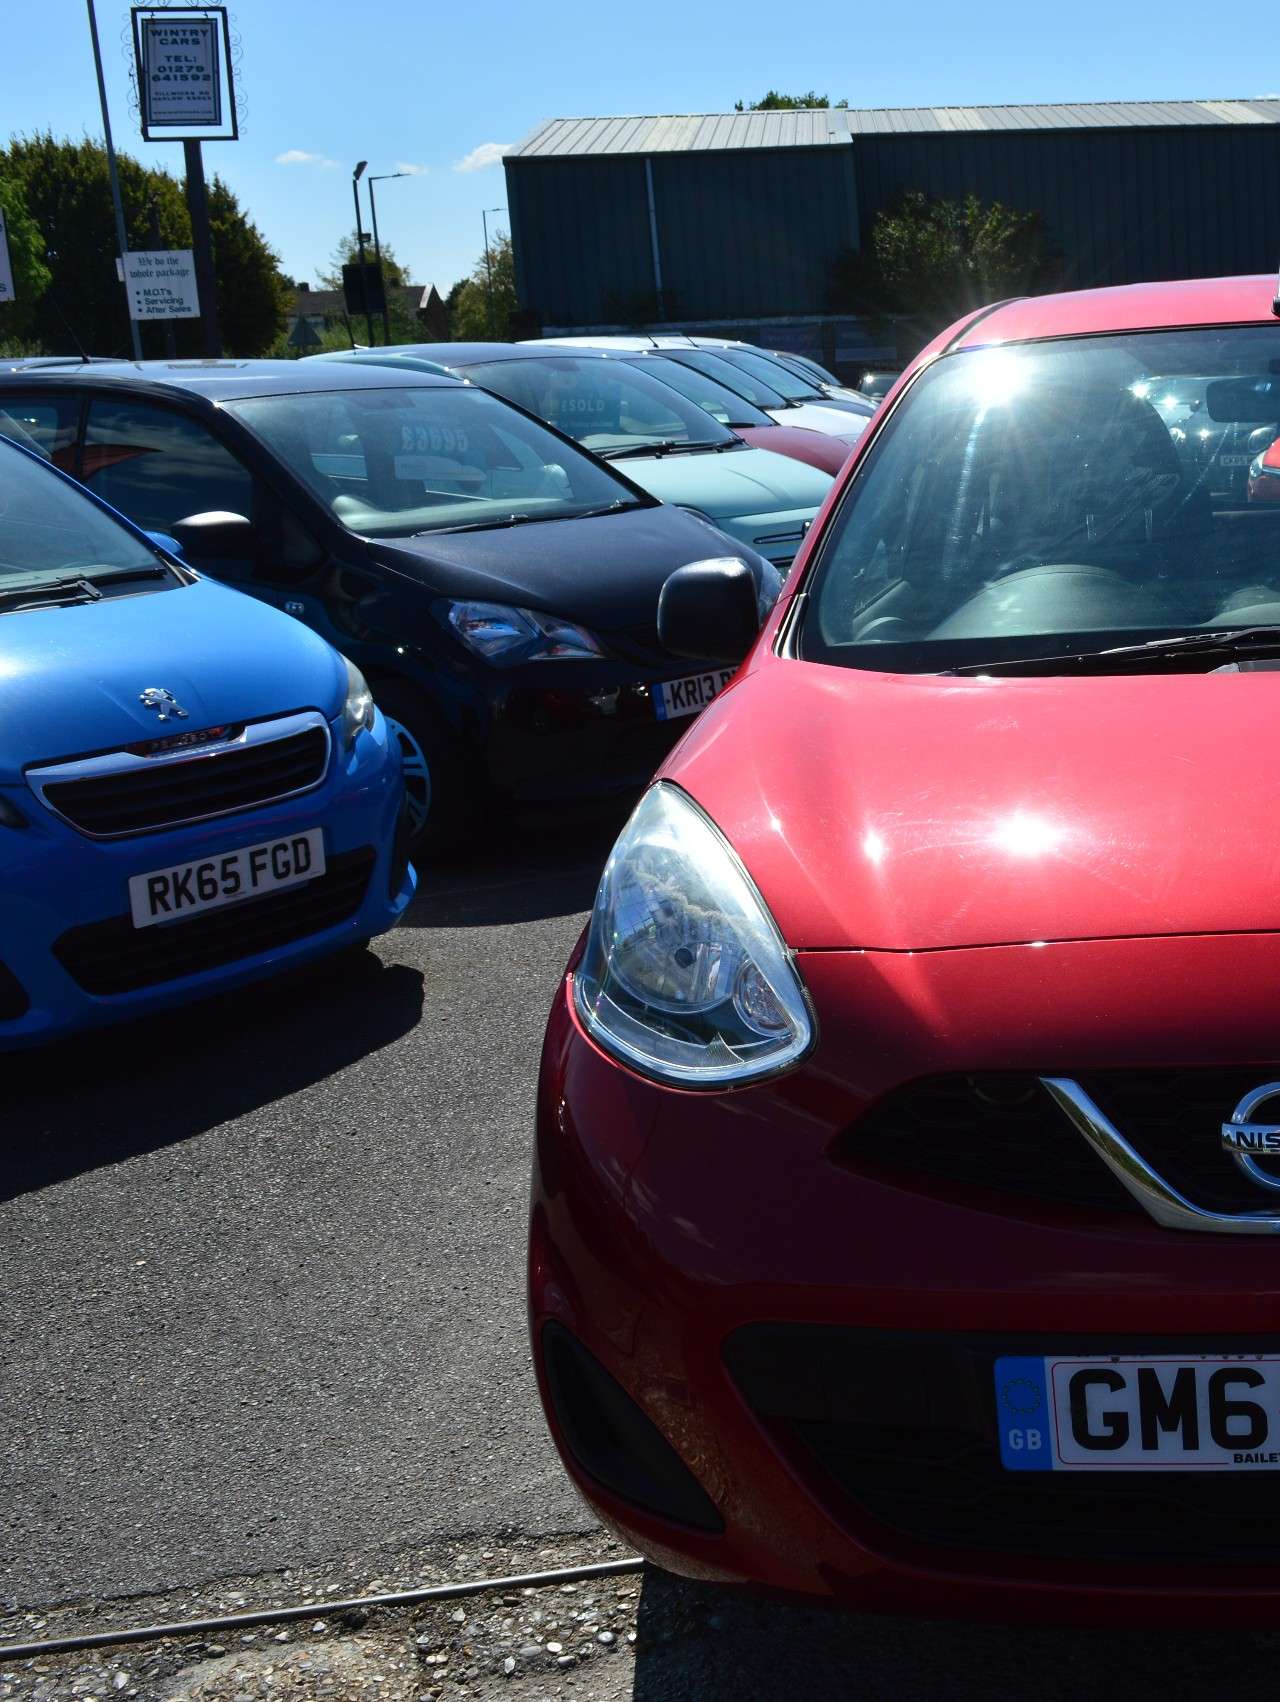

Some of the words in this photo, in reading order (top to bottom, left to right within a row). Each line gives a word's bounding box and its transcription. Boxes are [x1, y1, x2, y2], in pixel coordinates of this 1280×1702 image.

[149, 29, 209, 37] WINTRY
[159, 38, 200, 46] CARS
[157, 65, 204, 73] 01279
[147, 855, 242, 916] RK65
[249, 836, 312, 888] FGD
[1008, 1428, 1042, 1451] GB
